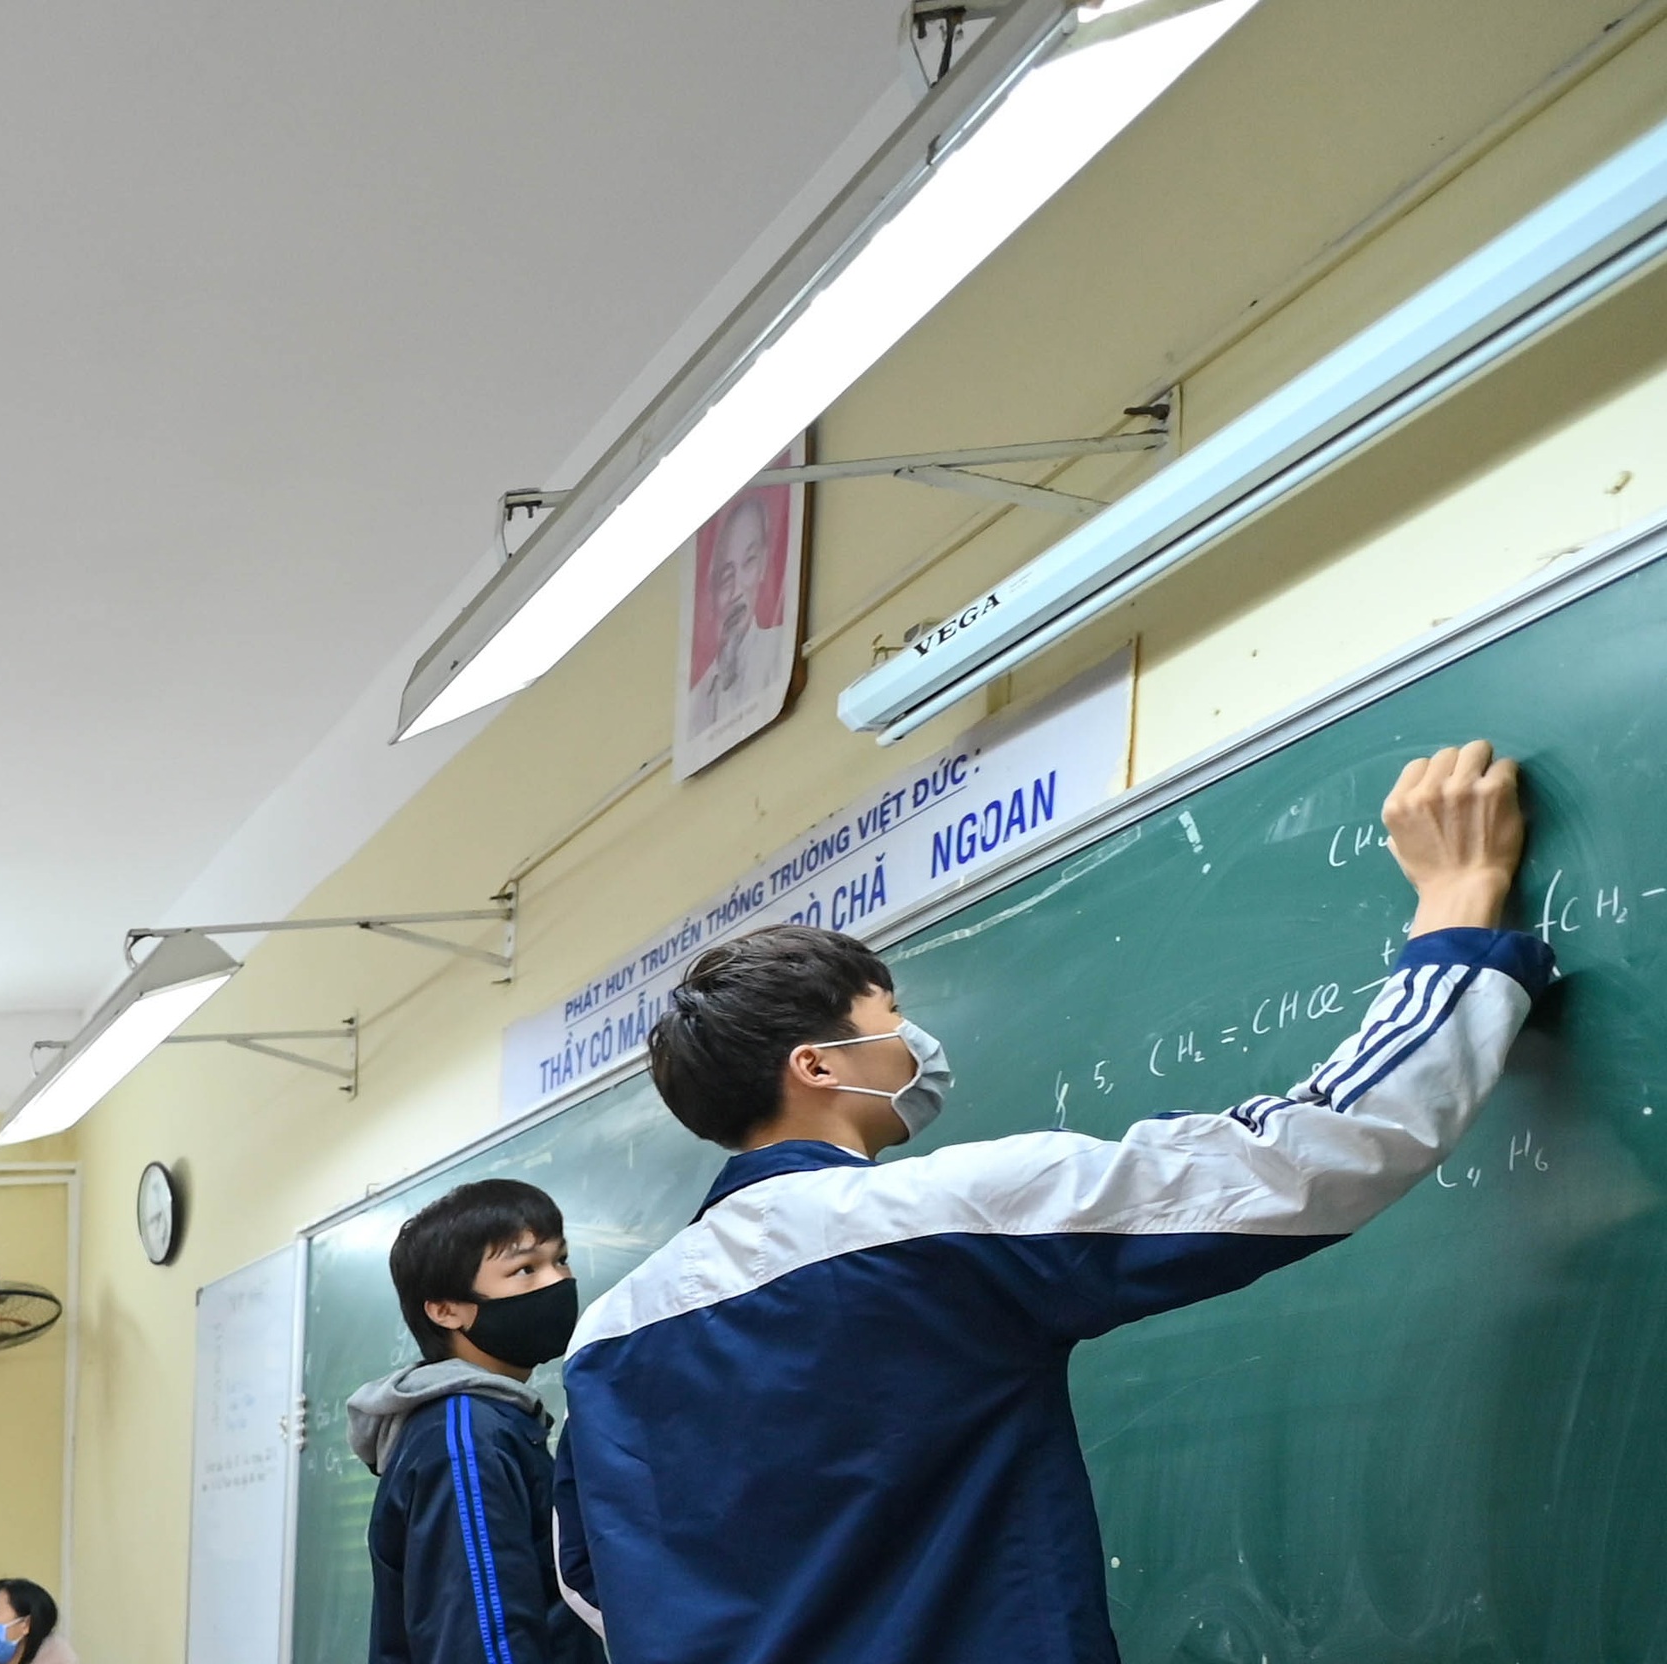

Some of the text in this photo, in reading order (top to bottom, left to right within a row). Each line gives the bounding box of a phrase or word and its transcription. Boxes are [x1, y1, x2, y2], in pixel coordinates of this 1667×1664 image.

[913, 592, 1000, 658] VEGA
[540, 1031, 587, 1094] THẦY
[590, 1018, 613, 1069] CÔ
[930, 770, 1056, 880] NGOAN
[564, 980, 601, 1022] PHÁT
[605, 962, 636, 999] HUY
[641, 917, 702, 976] TRUYỀN
[706, 880, 764, 936] THỐNG
[769, 825, 850, 895] TRƯỜNG
[857, 790, 906, 839] VIỆT
